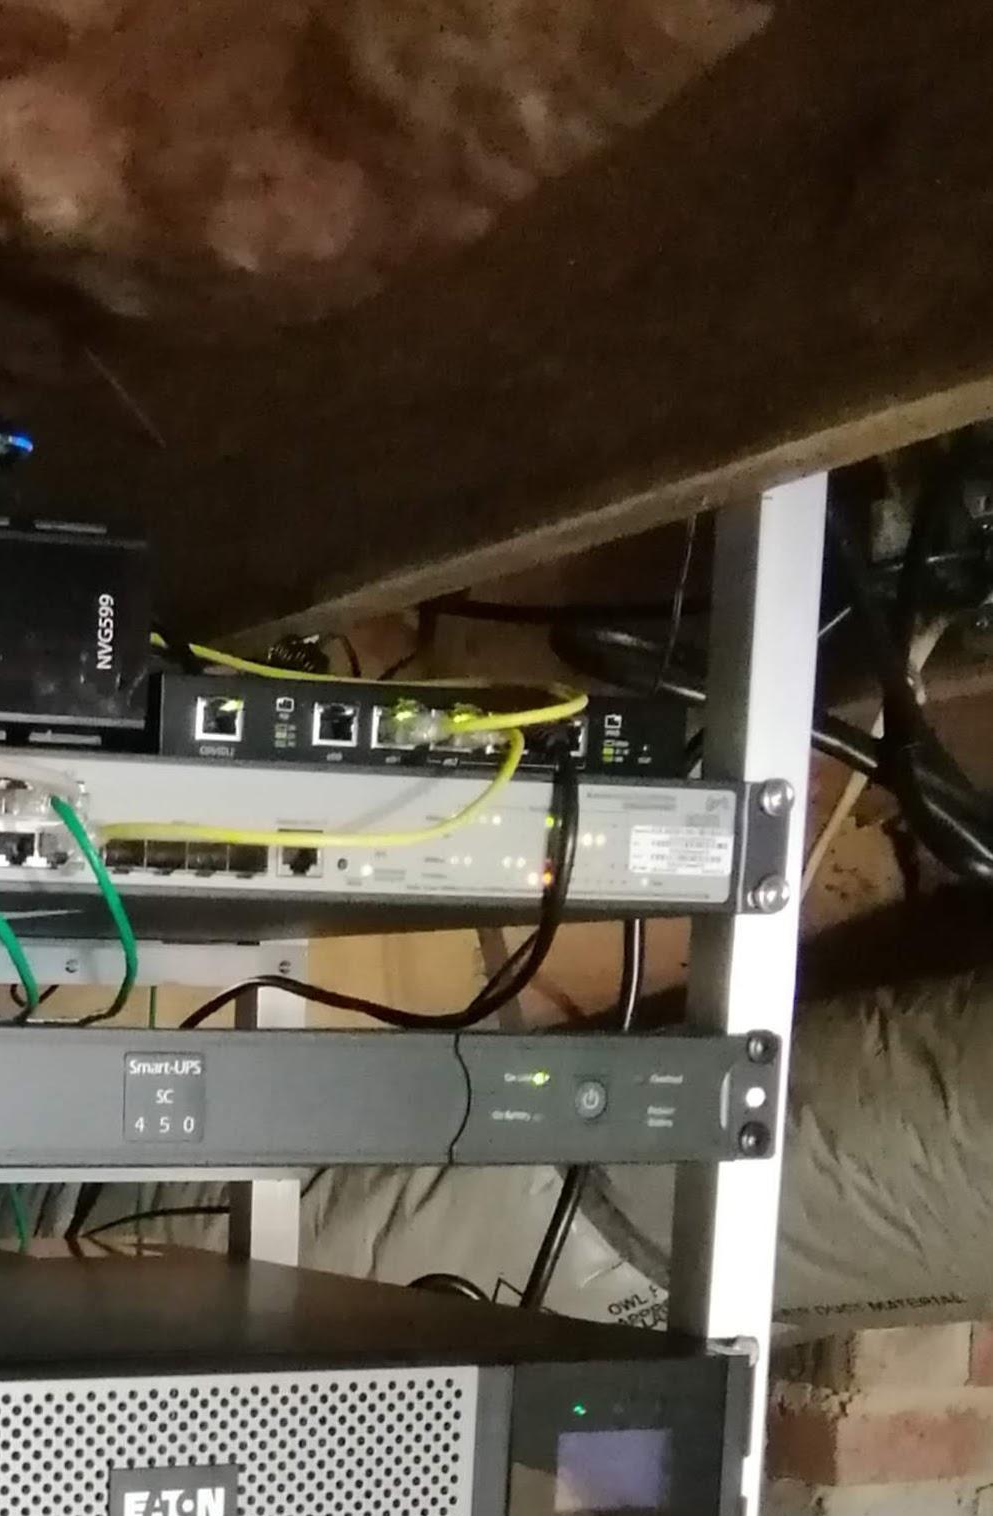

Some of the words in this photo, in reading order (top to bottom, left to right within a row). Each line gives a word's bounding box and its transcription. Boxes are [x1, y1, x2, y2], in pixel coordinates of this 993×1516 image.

[96, 593, 114, 669] NVG599
[129, 1059, 202, 1075] Smart-UPS
[155, 1088, 175, 1104] SC
